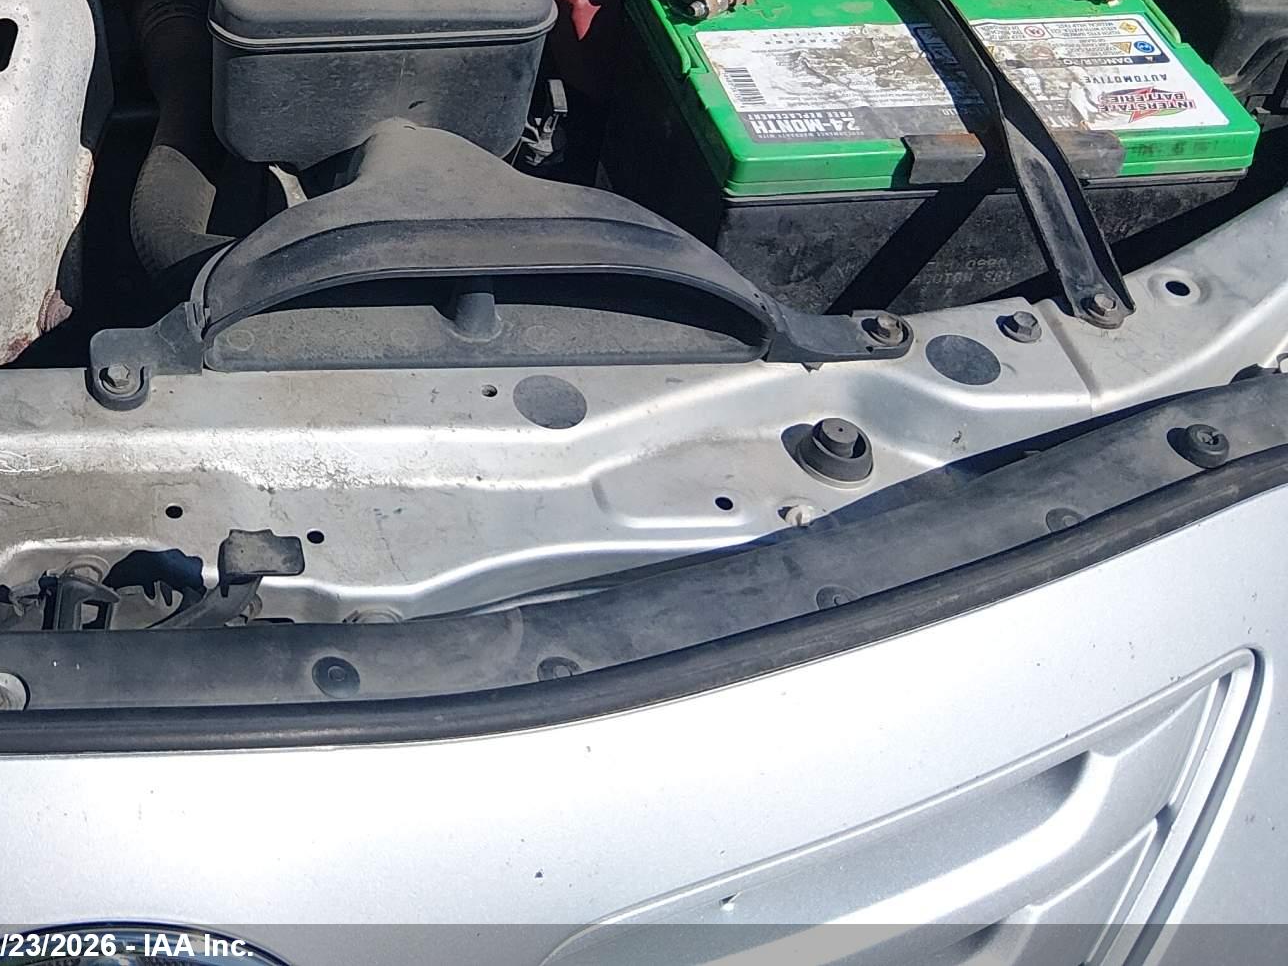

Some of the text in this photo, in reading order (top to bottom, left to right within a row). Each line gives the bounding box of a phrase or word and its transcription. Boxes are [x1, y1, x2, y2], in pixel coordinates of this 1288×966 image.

[1083, 73, 1168, 84] AUTOMOTIVE
[1099, 92, 1185, 103] BATTERIES
[1098, 100, 1195, 112] INTERSTATE
[749, 117, 861, 134] 24-MONTH
